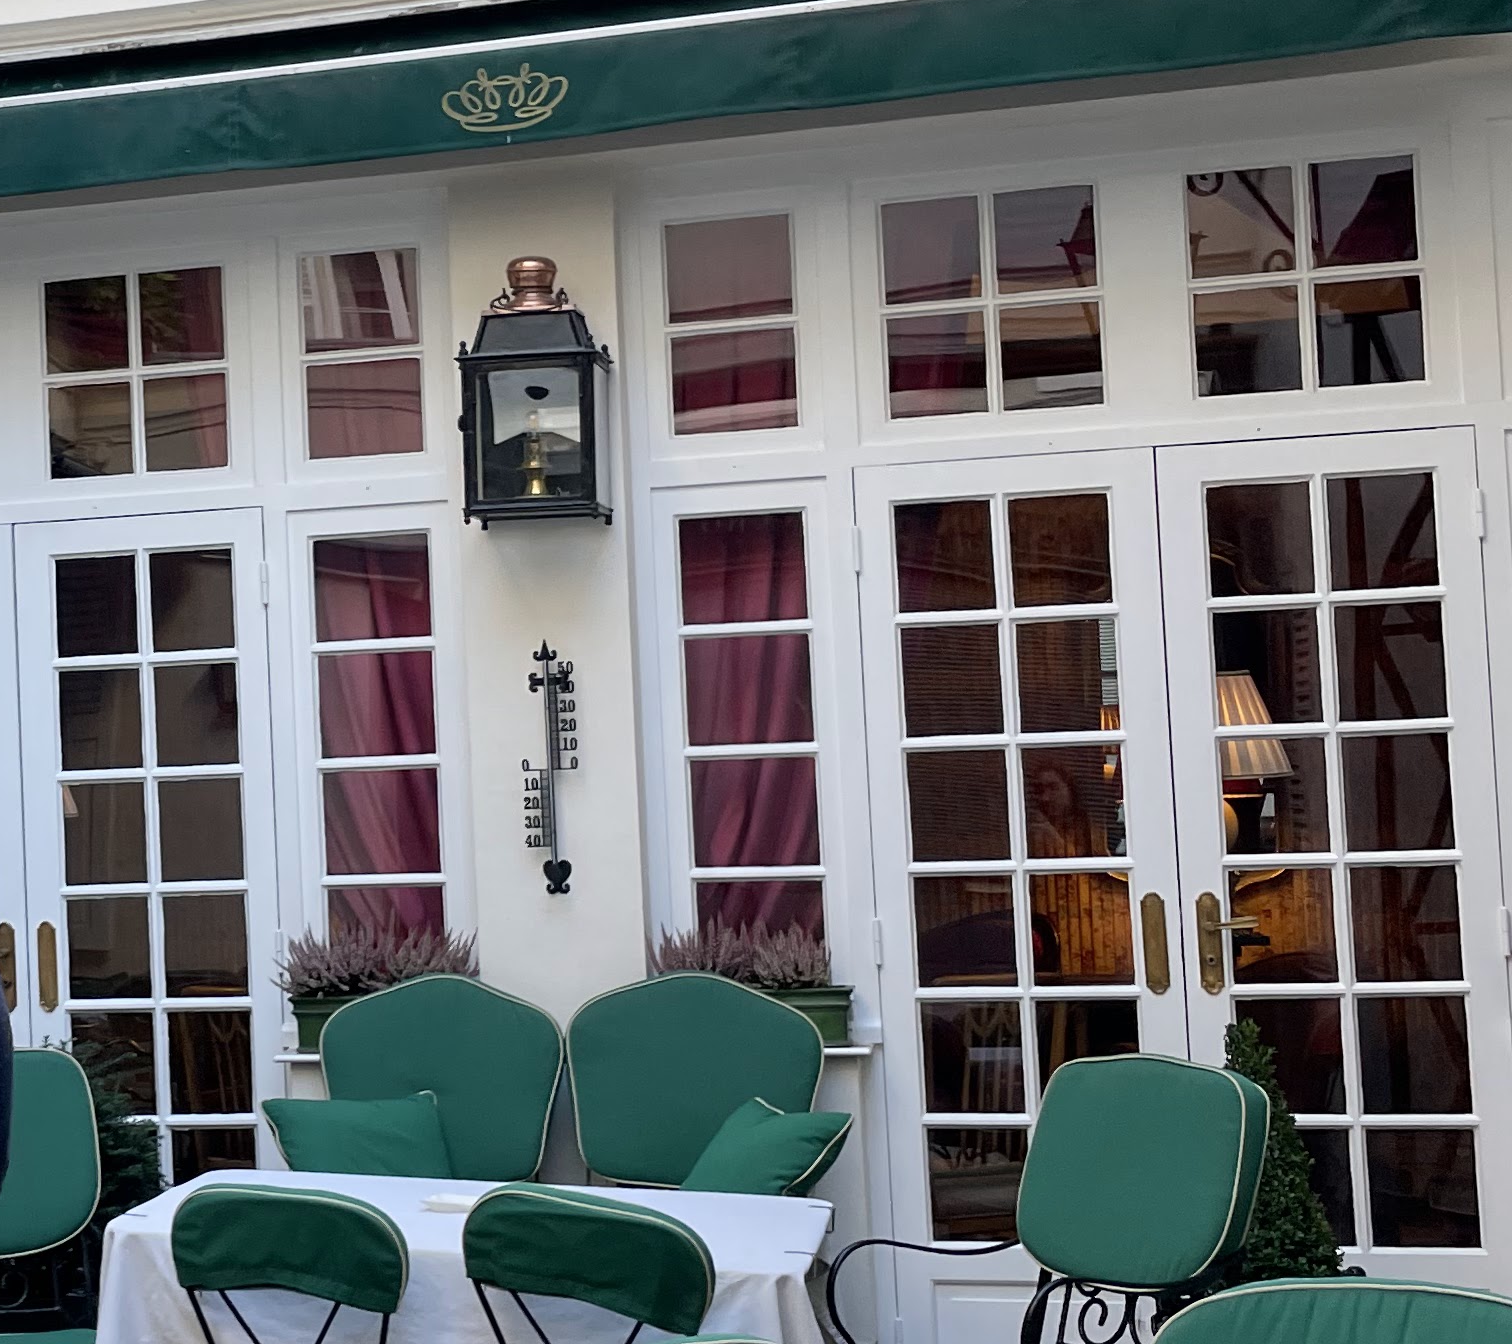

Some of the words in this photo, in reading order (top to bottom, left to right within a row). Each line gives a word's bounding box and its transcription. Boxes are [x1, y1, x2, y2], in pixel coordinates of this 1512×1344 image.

[558, 680, 574, 693] 0
[559, 700, 575, 712] 30
[560, 718, 577, 731] 20
[563, 737, 578, 750] 10
[522, 759, 530, 771] 0
[571, 757, 578, 769] 0
[524, 778, 539, 791] 10
[524, 797, 539, 810] 20
[525, 816, 540, 829] 30
[525, 835, 541, 847] 40
